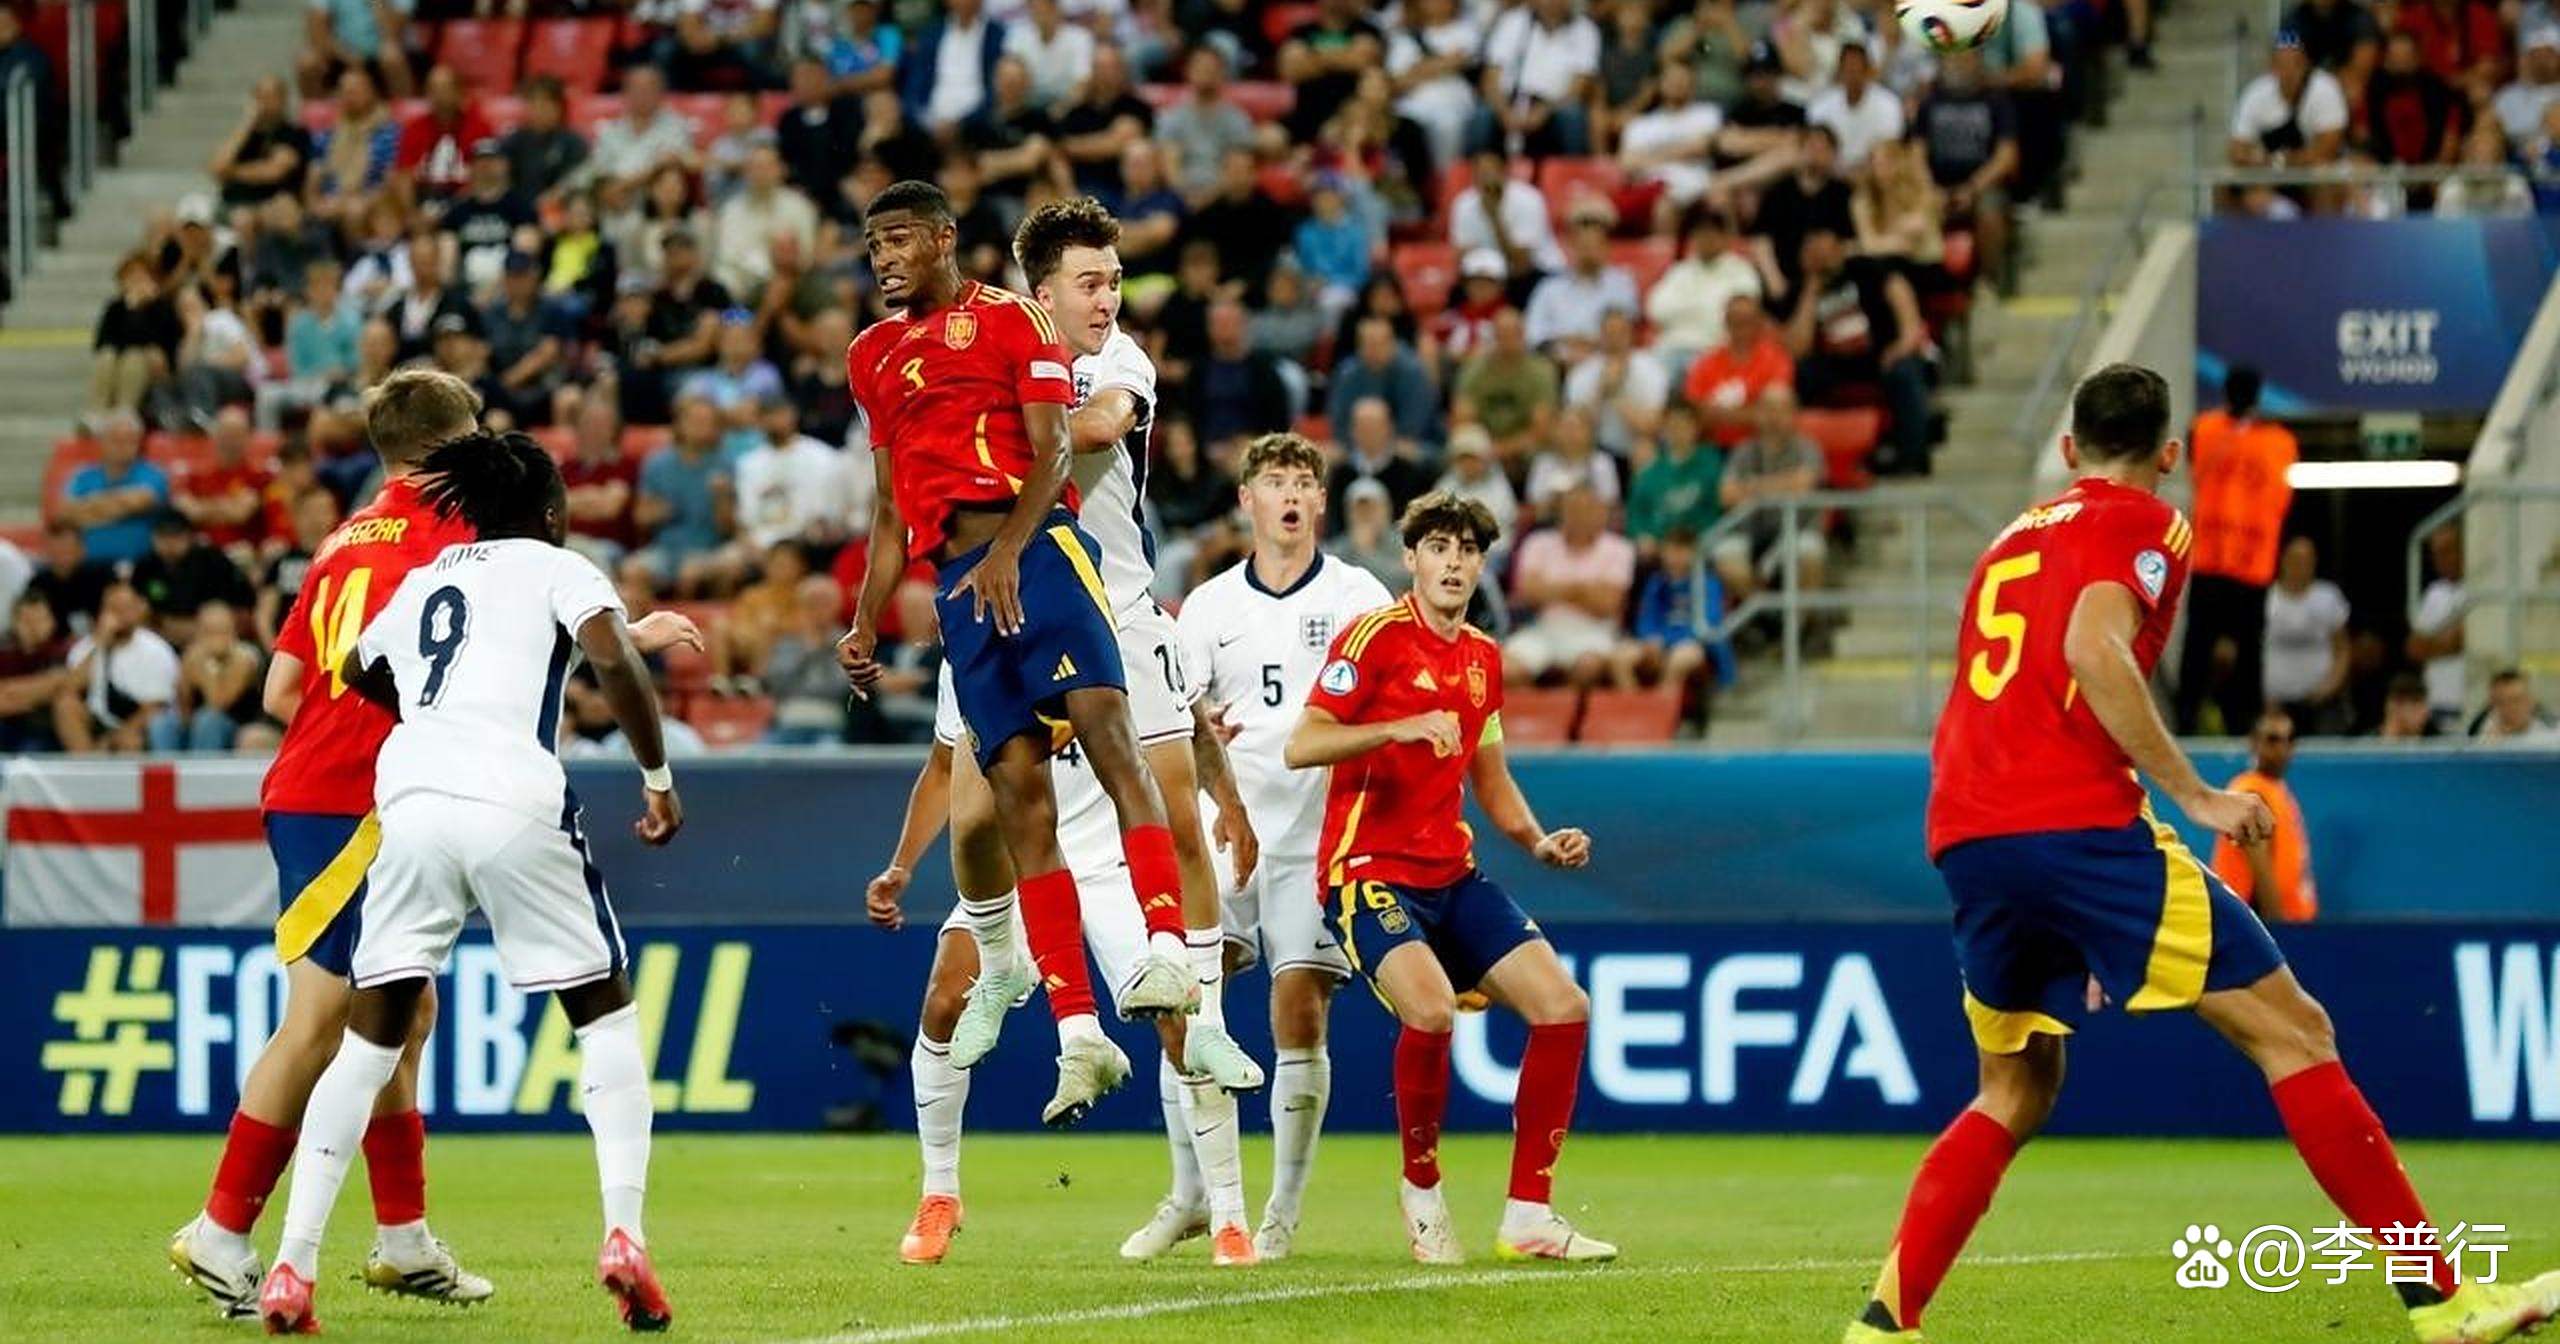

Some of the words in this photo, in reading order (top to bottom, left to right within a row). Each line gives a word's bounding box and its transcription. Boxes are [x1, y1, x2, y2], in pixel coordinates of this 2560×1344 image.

[2337, 310, 2440, 356] EXIT
[901, 357, 926, 398] 3
[310, 566, 372, 700] 14
[418, 584, 470, 708] 9
[1969, 551, 2041, 701] 5
[1261, 664, 1284, 708] 5
[1361, 880, 1398, 910] 6
[41, 943, 757, 1117] #FOBALL
